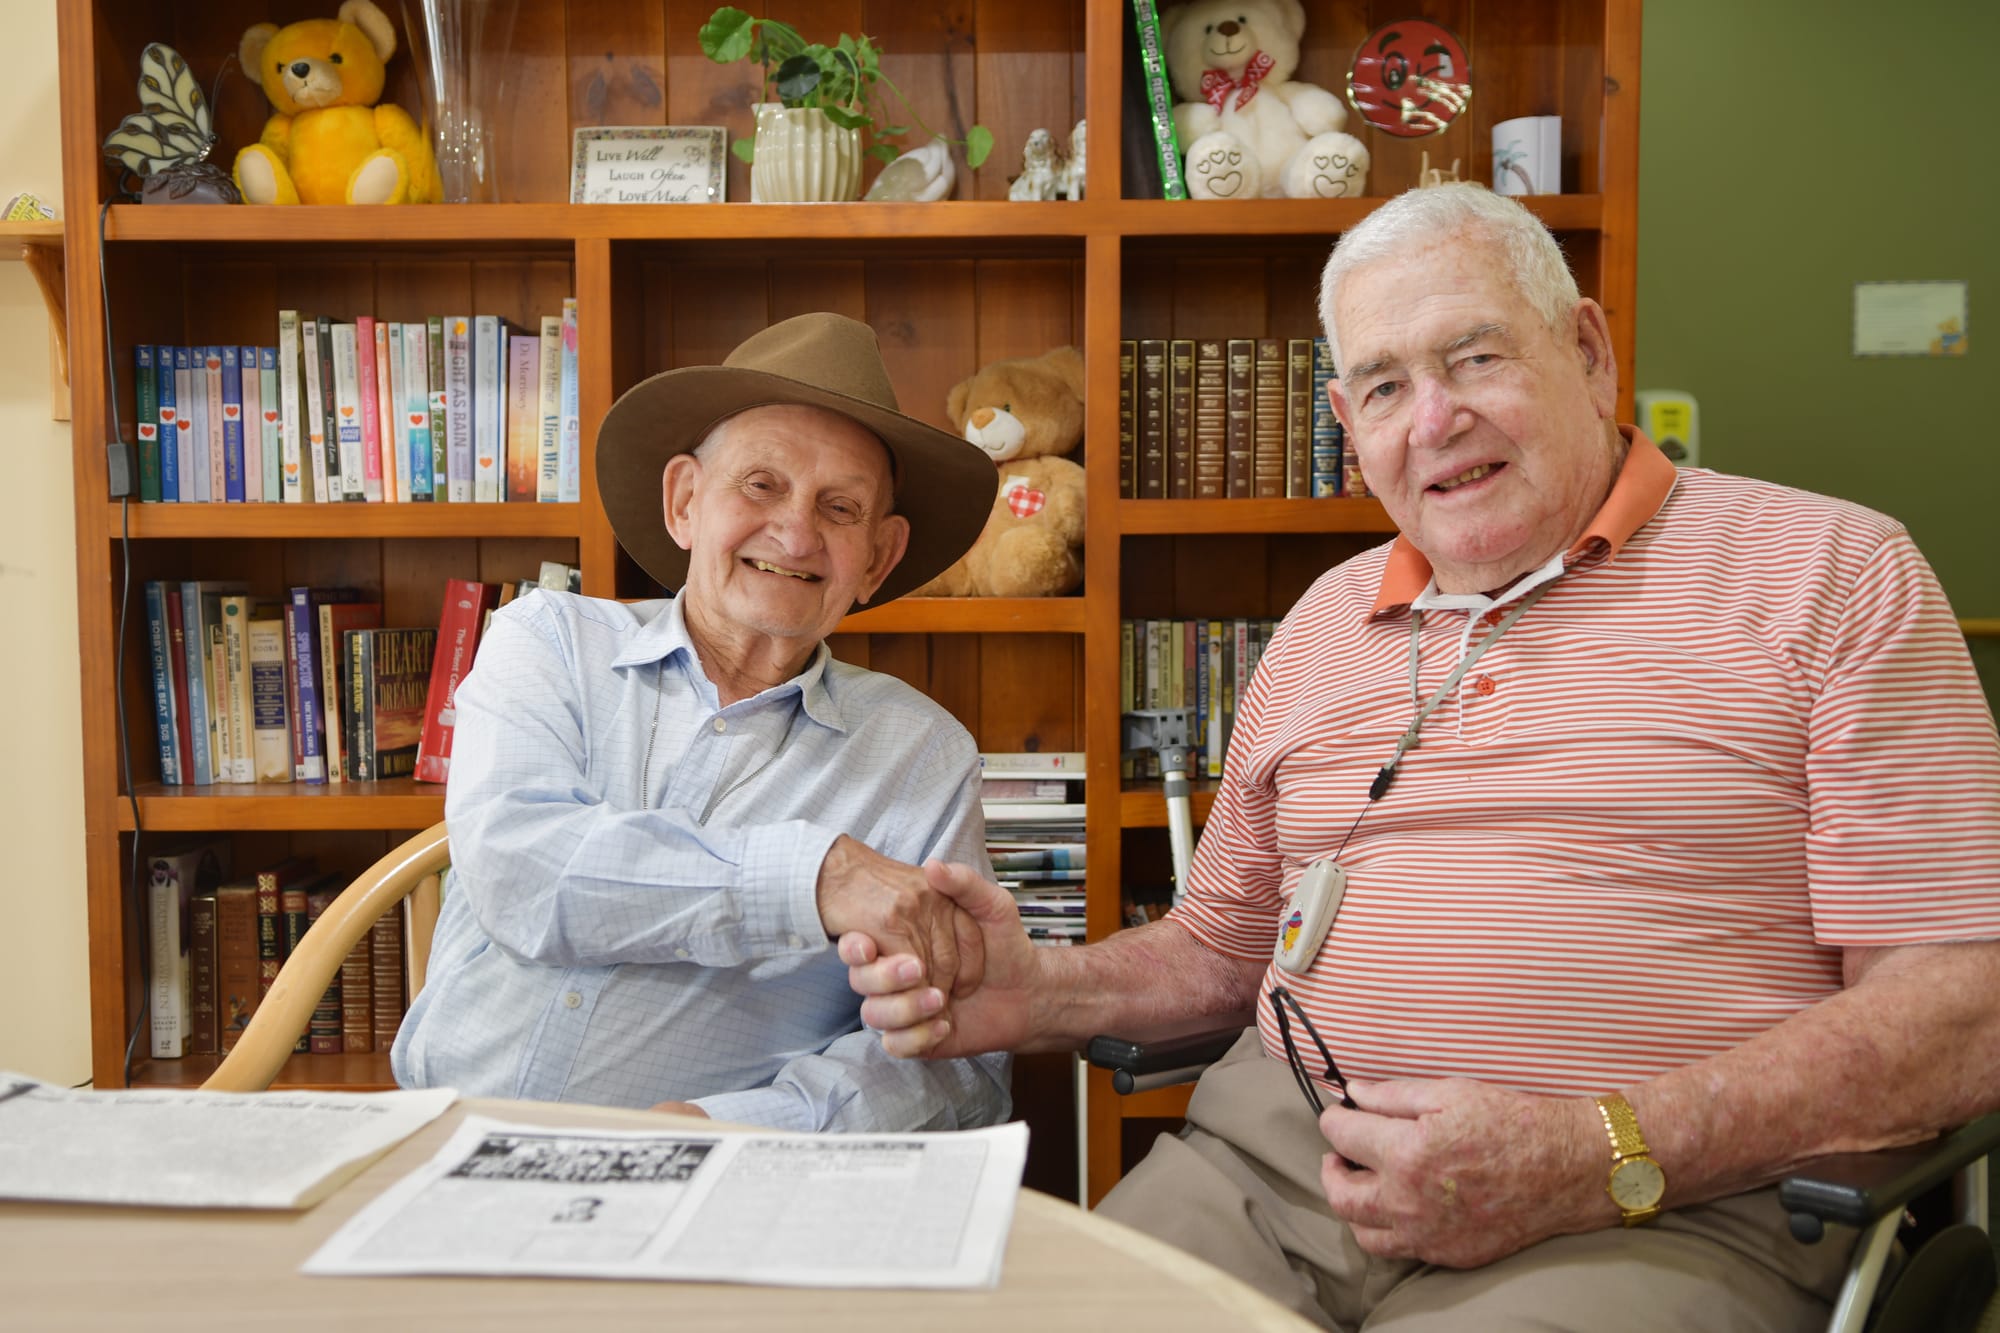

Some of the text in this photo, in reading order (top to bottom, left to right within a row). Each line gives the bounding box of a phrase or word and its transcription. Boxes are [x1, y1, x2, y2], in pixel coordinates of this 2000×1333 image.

[1143, 25, 1161, 73] WORLD
[1151, 77, 1170, 139] RECORDS
[596, 146, 664, 161] LIVE Well
[609, 169, 645, 181] LAUGH
[619, 191, 648, 202] LOVE
[519, 342, 531, 357] Di
[453, 388, 467, 408] AS
[515, 359, 532, 410] Morrissey
[545, 346, 559, 402] Anne Mather
[453, 412, 467, 447] RAIN
[543, 414, 559, 481] Alien Wife
[151, 619, 168, 718] BOBBY ON THE BEAT
[297, 631, 313, 688] SPIN DOCTOR
[322, 611, 335, 712] GREAT WORKING DOG STORIES
[379, 632, 431, 675] HEART
[444, 628, 467, 709] The Silent Country
[160, 723, 170, 741] BOB
[304, 701, 315, 755] MICHAEL SHEA
[159, 962, 169, 1009] WISDEN
